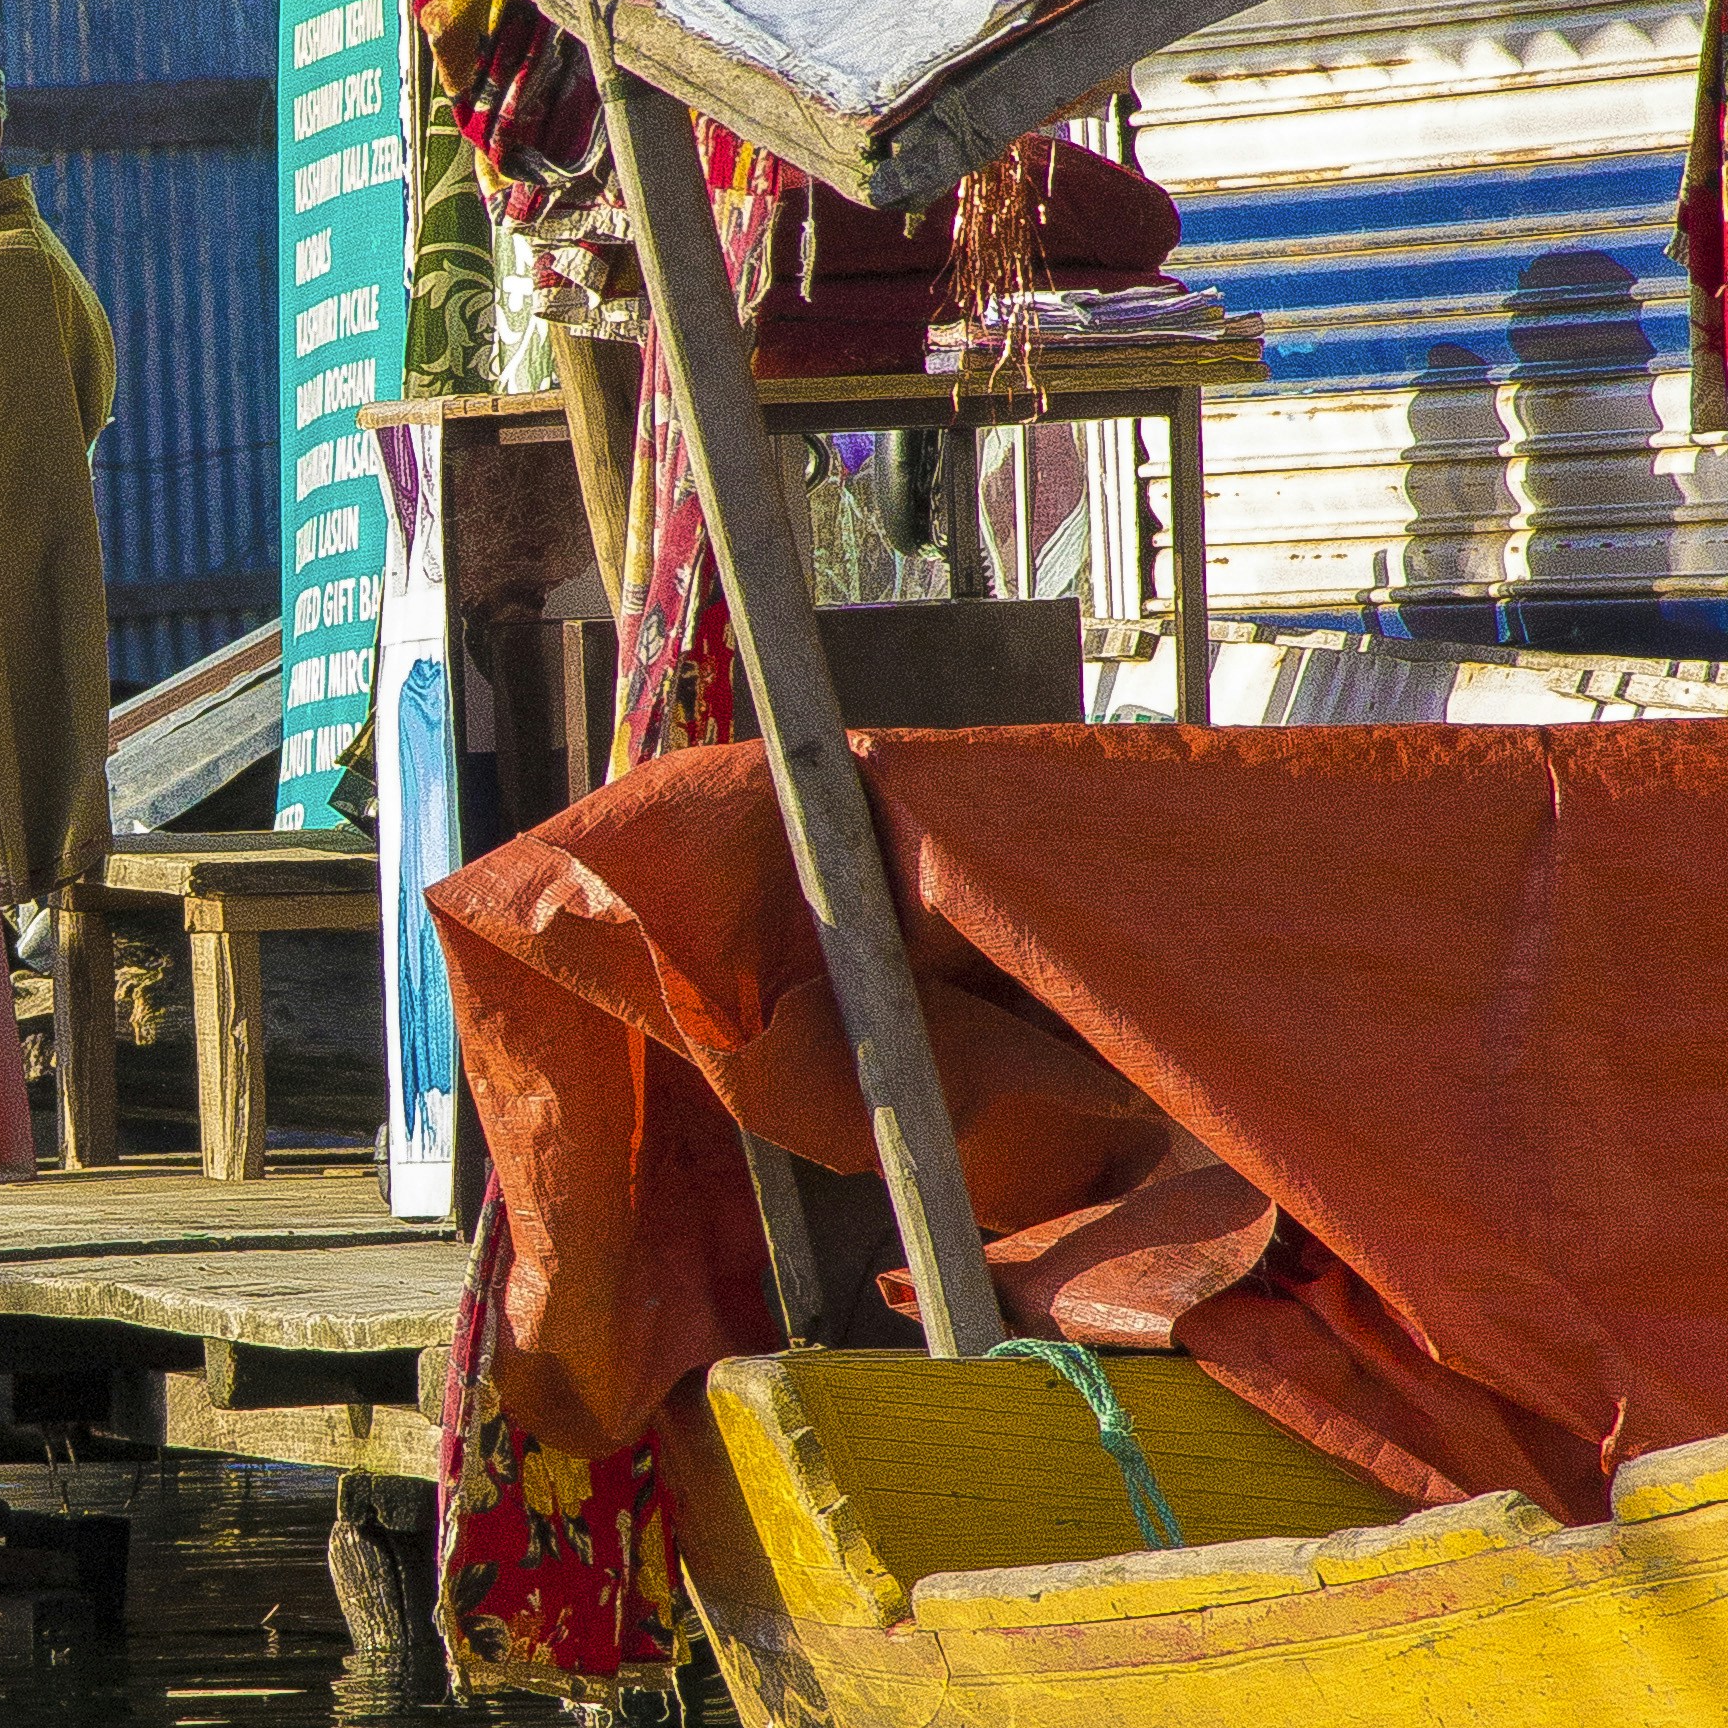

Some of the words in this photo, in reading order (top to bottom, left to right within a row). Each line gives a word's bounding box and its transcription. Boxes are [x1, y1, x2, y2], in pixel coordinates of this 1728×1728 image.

[344, 68, 381, 121] SPICES
[342, 143, 369, 193] KALA
[340, 285, 379, 338] PICKLE
[324, 362, 375, 412] ROGHAN
[334, 430, 377, 481] MASAL
[319, 506, 359, 558] LASUN
[323, 578, 356, 626] GIFT
[316, 722, 362, 772] MUR
